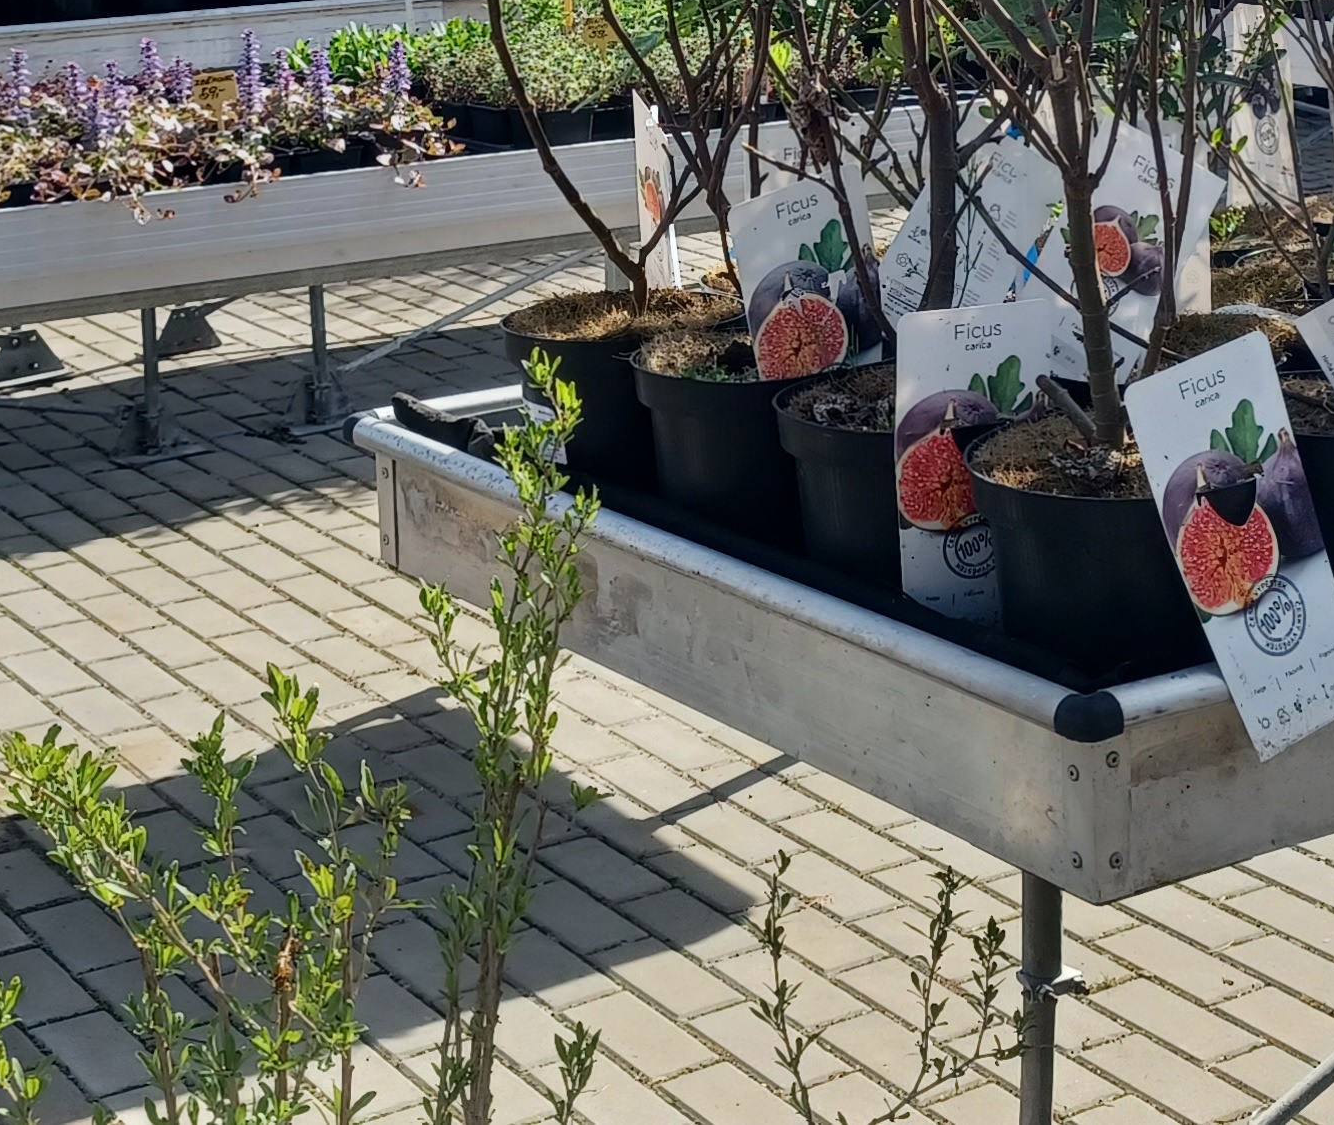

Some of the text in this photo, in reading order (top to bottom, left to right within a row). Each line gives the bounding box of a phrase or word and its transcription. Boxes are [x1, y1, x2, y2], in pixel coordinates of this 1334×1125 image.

[199, 86, 226, 100] 59,-
[1133, 155, 1175, 189] Fics
[775, 194, 818, 220] Ficus
[788, 212, 812, 226] carica
[954, 323, 1002, 340] Ficus
[965, 341, 992, 351] carica
[1178, 370, 1226, 400] Ficus
[1195, 391, 1220, 409] carica
[1260, 596, 1293, 635] 100%
